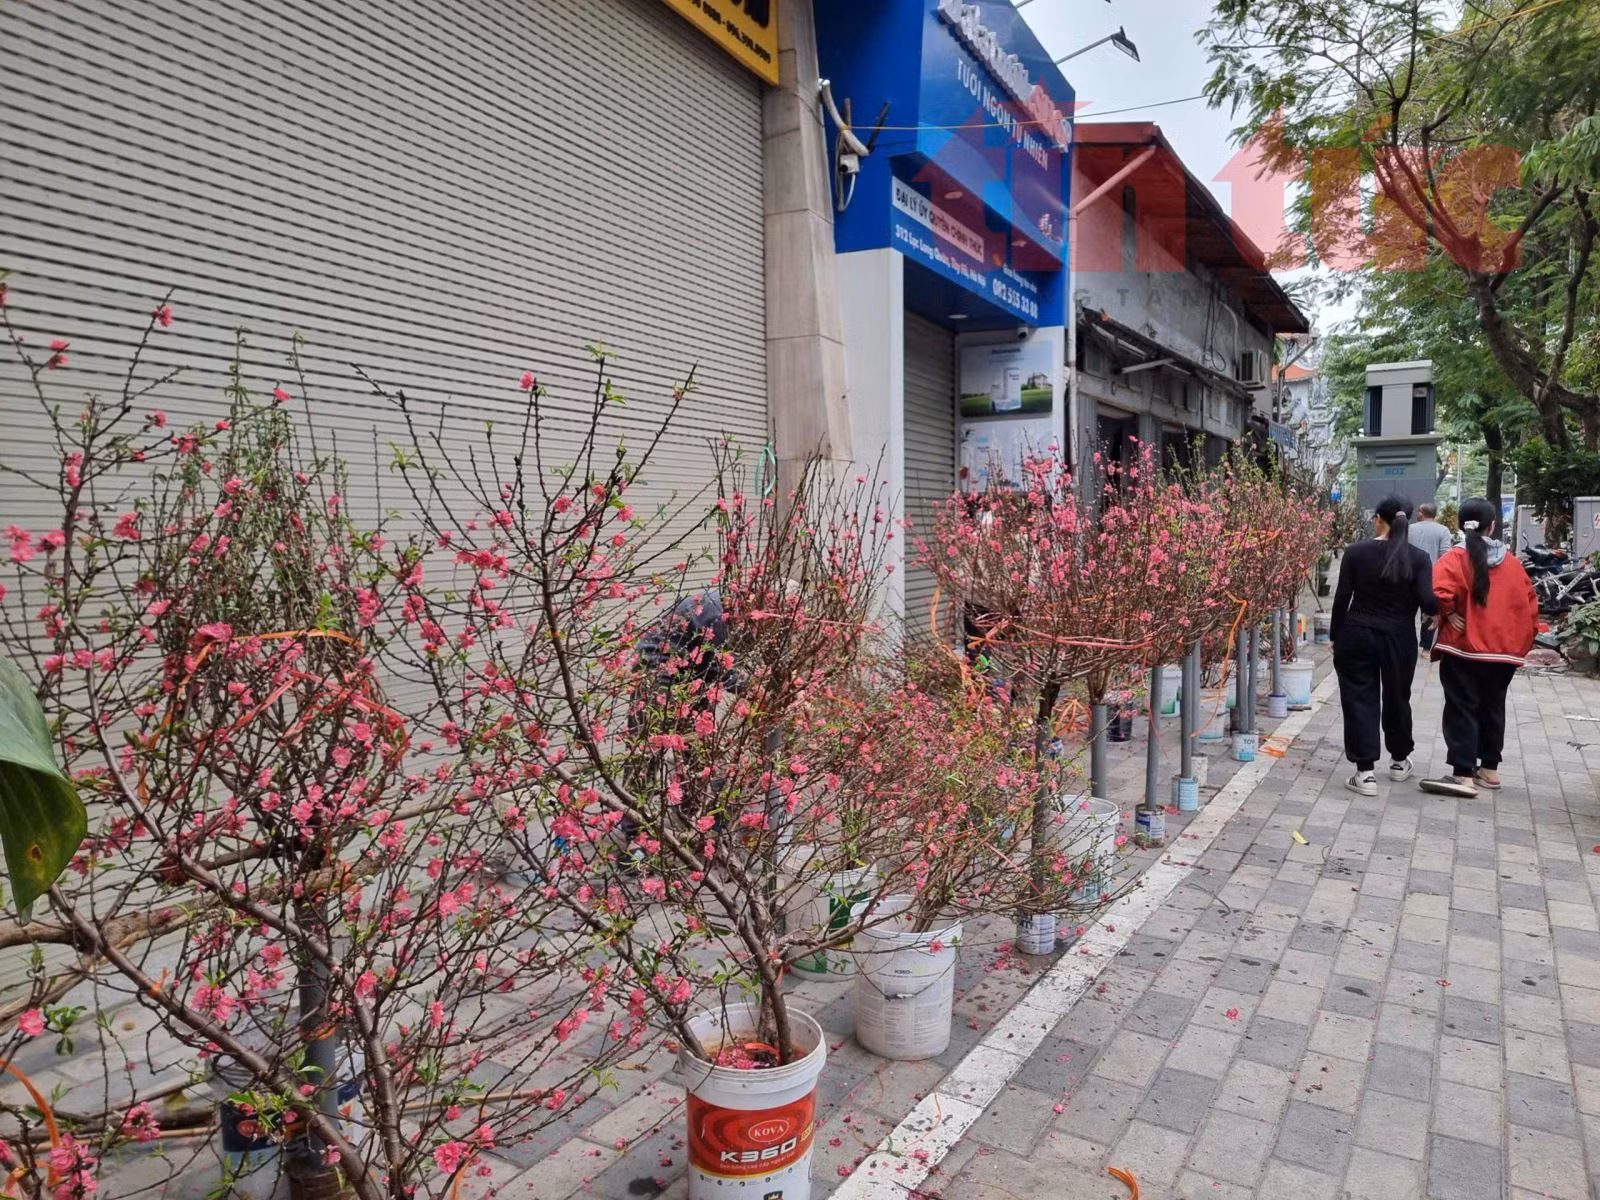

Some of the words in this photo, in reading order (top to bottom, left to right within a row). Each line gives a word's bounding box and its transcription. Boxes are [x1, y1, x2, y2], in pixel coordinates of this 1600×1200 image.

[983, 86, 1010, 132] NGON
[754, 1125, 784, 1136] KOVA
[720, 1137, 797, 1162] K360
